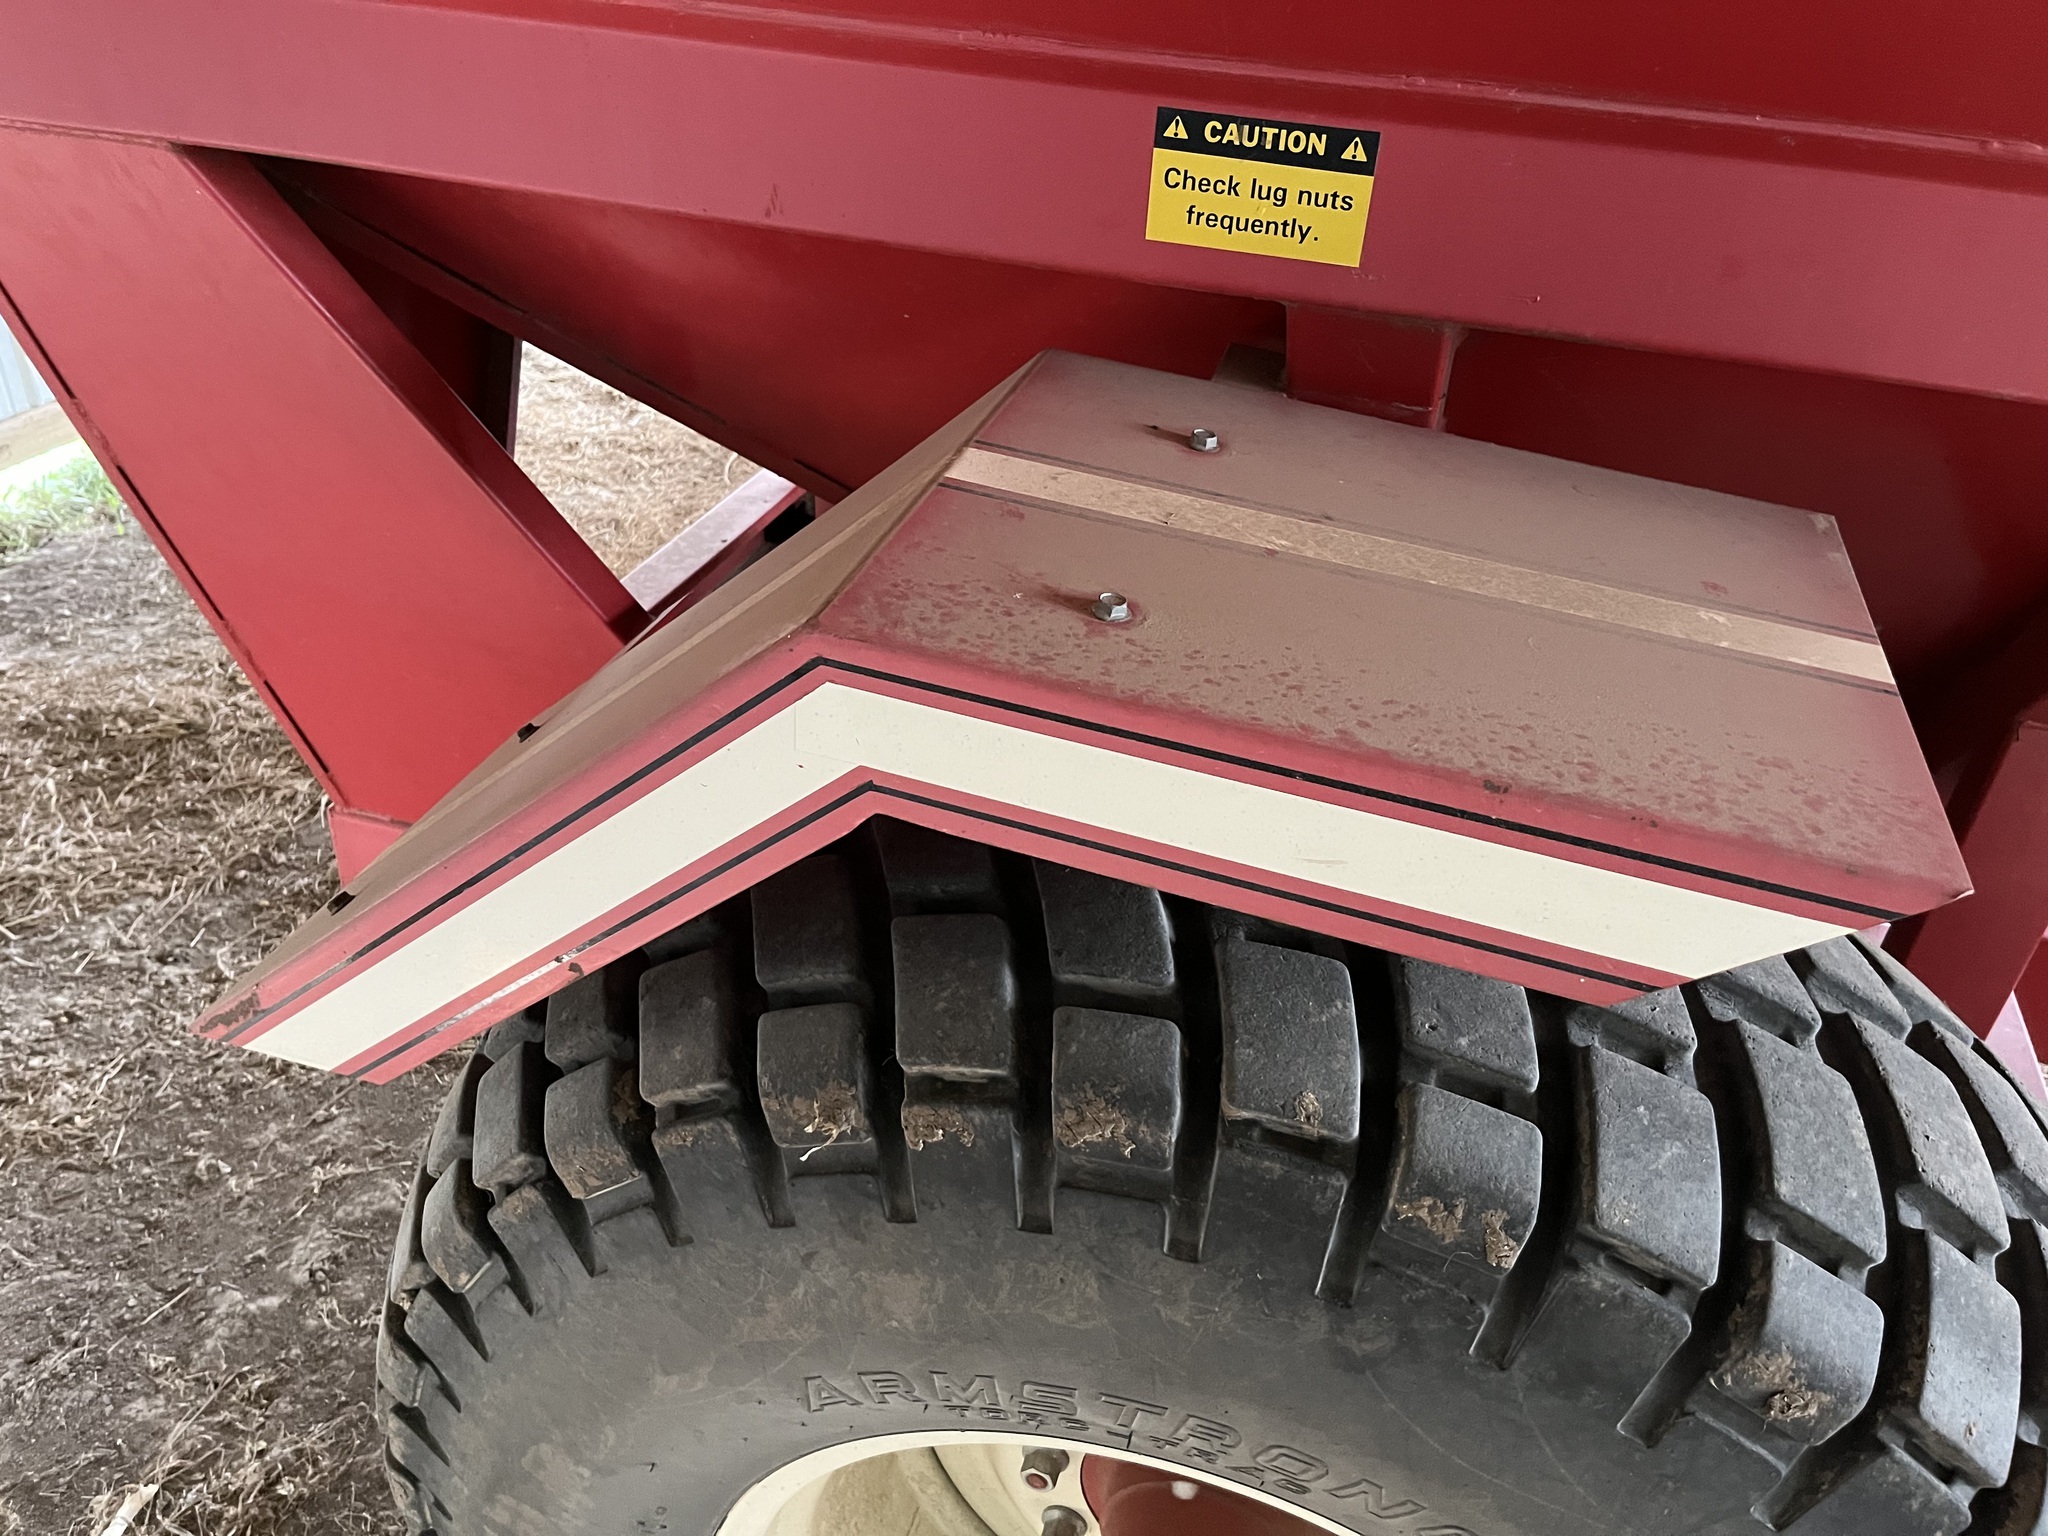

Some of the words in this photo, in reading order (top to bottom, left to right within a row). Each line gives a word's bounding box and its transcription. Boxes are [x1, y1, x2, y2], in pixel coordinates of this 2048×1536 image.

[1204, 120, 1327, 156] CAUTION
[1164, 167, 1241, 197] Check
[1250, 178, 1288, 207] lug
[1297, 189, 1354, 211] nuts
[1186, 205, 1319, 244] frequently.
[803, 1370, 1479, 1536] ARMSTRON
